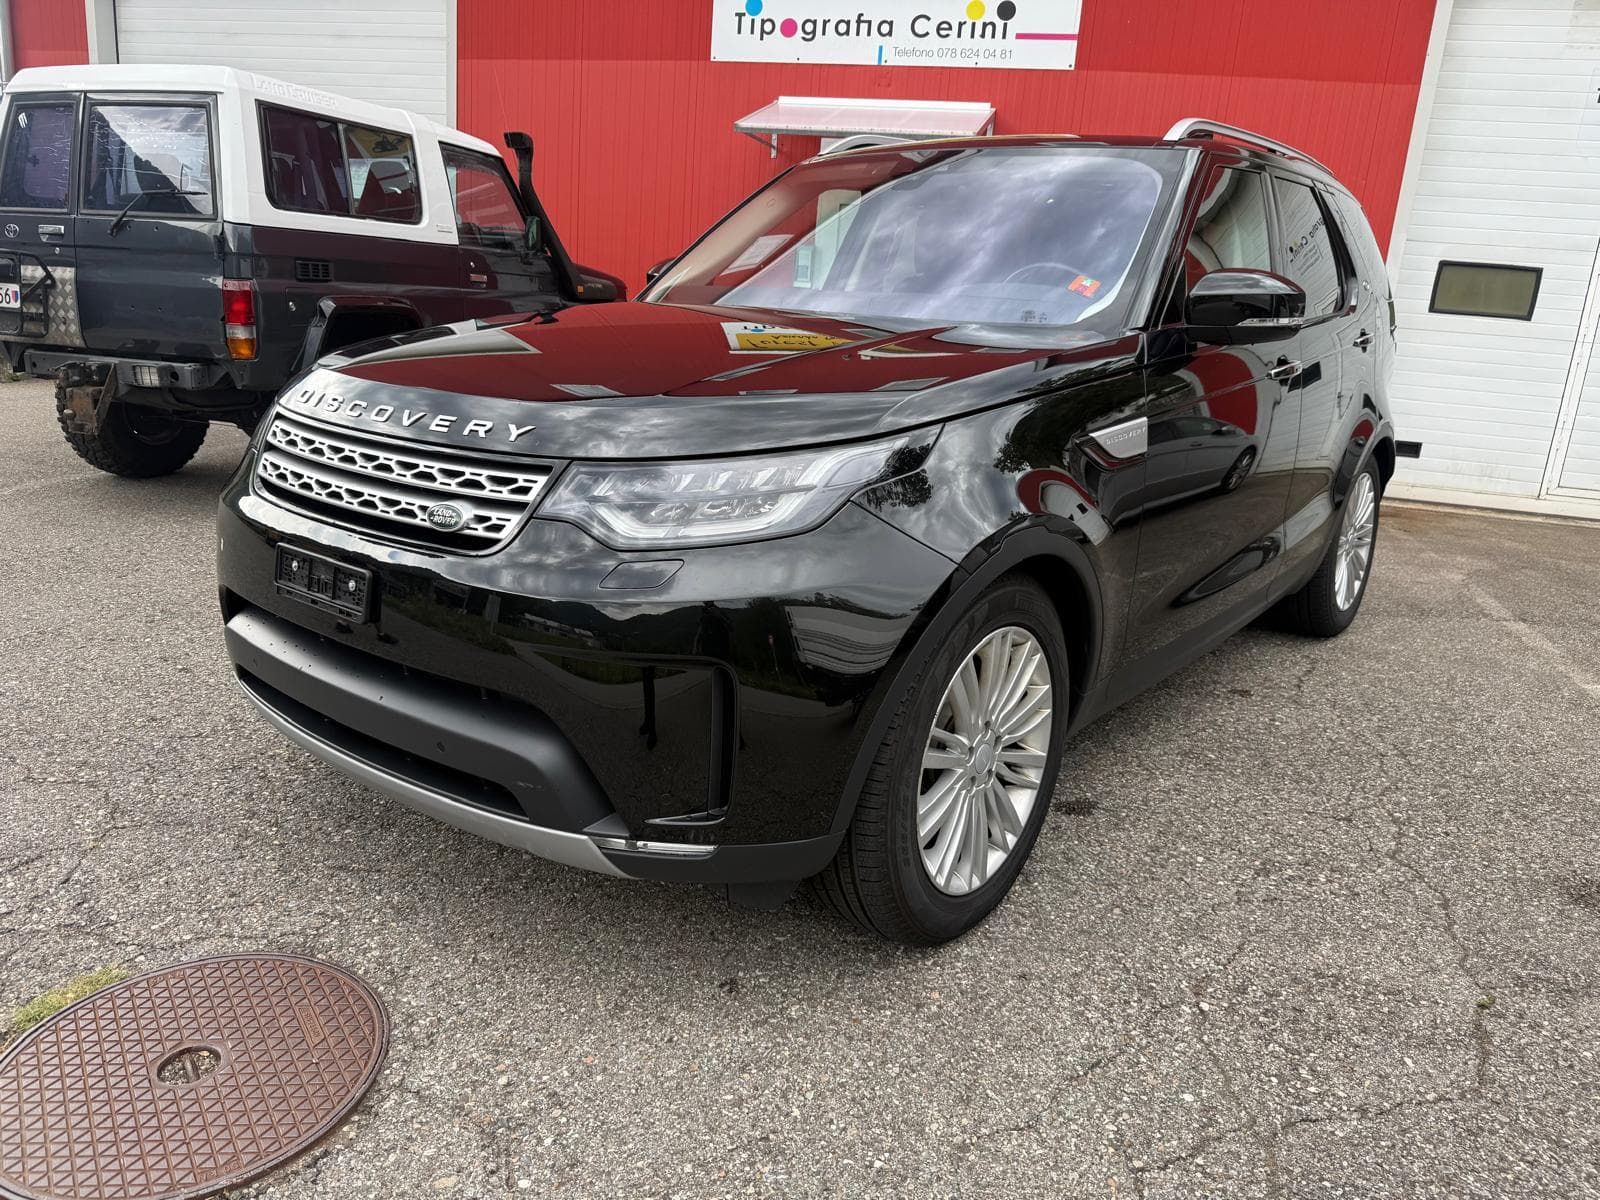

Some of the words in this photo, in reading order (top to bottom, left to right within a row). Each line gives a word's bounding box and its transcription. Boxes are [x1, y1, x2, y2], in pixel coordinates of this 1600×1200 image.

[735, 10, 894, 42] Tipografia
[910, 4, 1013, 40] Cerini
[893, 47, 934, 57] Telefono
[937, 48, 957, 58] 078
[960, 49, 980, 59] 624
[983, 49, 996, 59] 04
[1000, 50, 1013, 59] 81
[296, 389, 536, 442] DISCOVERY
[432, 515, 456, 526] ROVER
